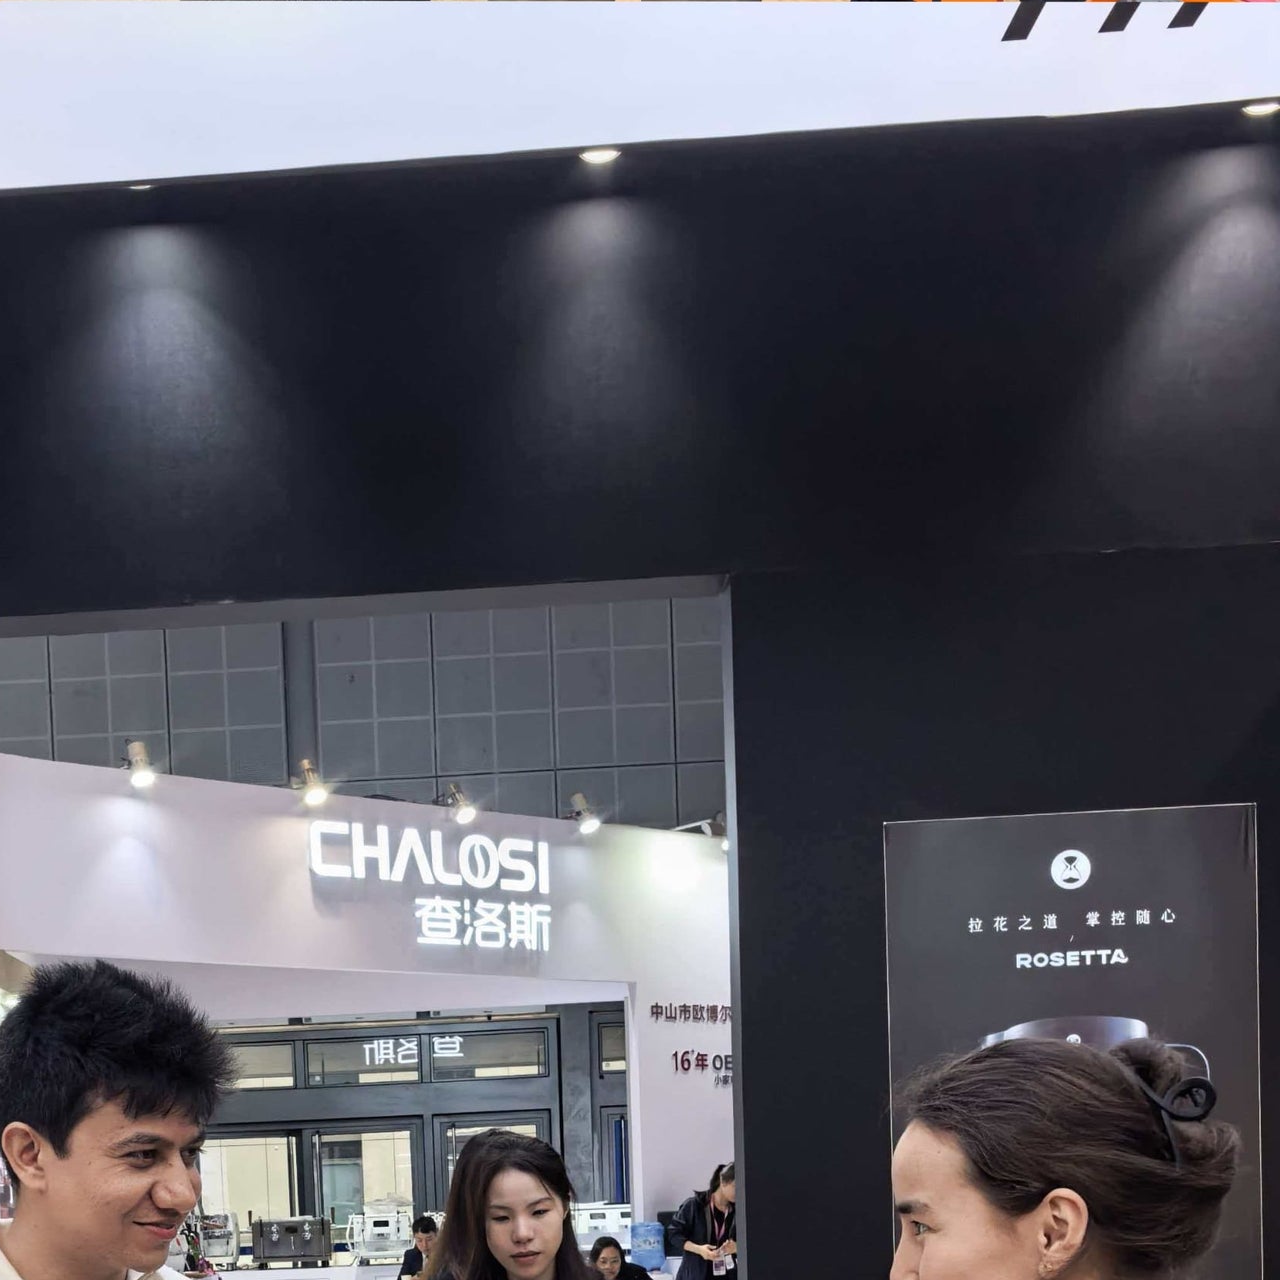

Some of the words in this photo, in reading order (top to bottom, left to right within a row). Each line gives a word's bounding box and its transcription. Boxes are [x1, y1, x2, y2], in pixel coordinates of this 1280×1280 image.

[308, 820, 550, 895] CHALOSI
[414, 896, 551, 952] 查洛斯
[968, 913, 1059, 933] 拉花之道
[1085, 908, 1177, 928] 掌控随心
[1015, 947, 1129, 969] ROSETTA
[650, 1002, 732, 1023] 中山市欧博尔
